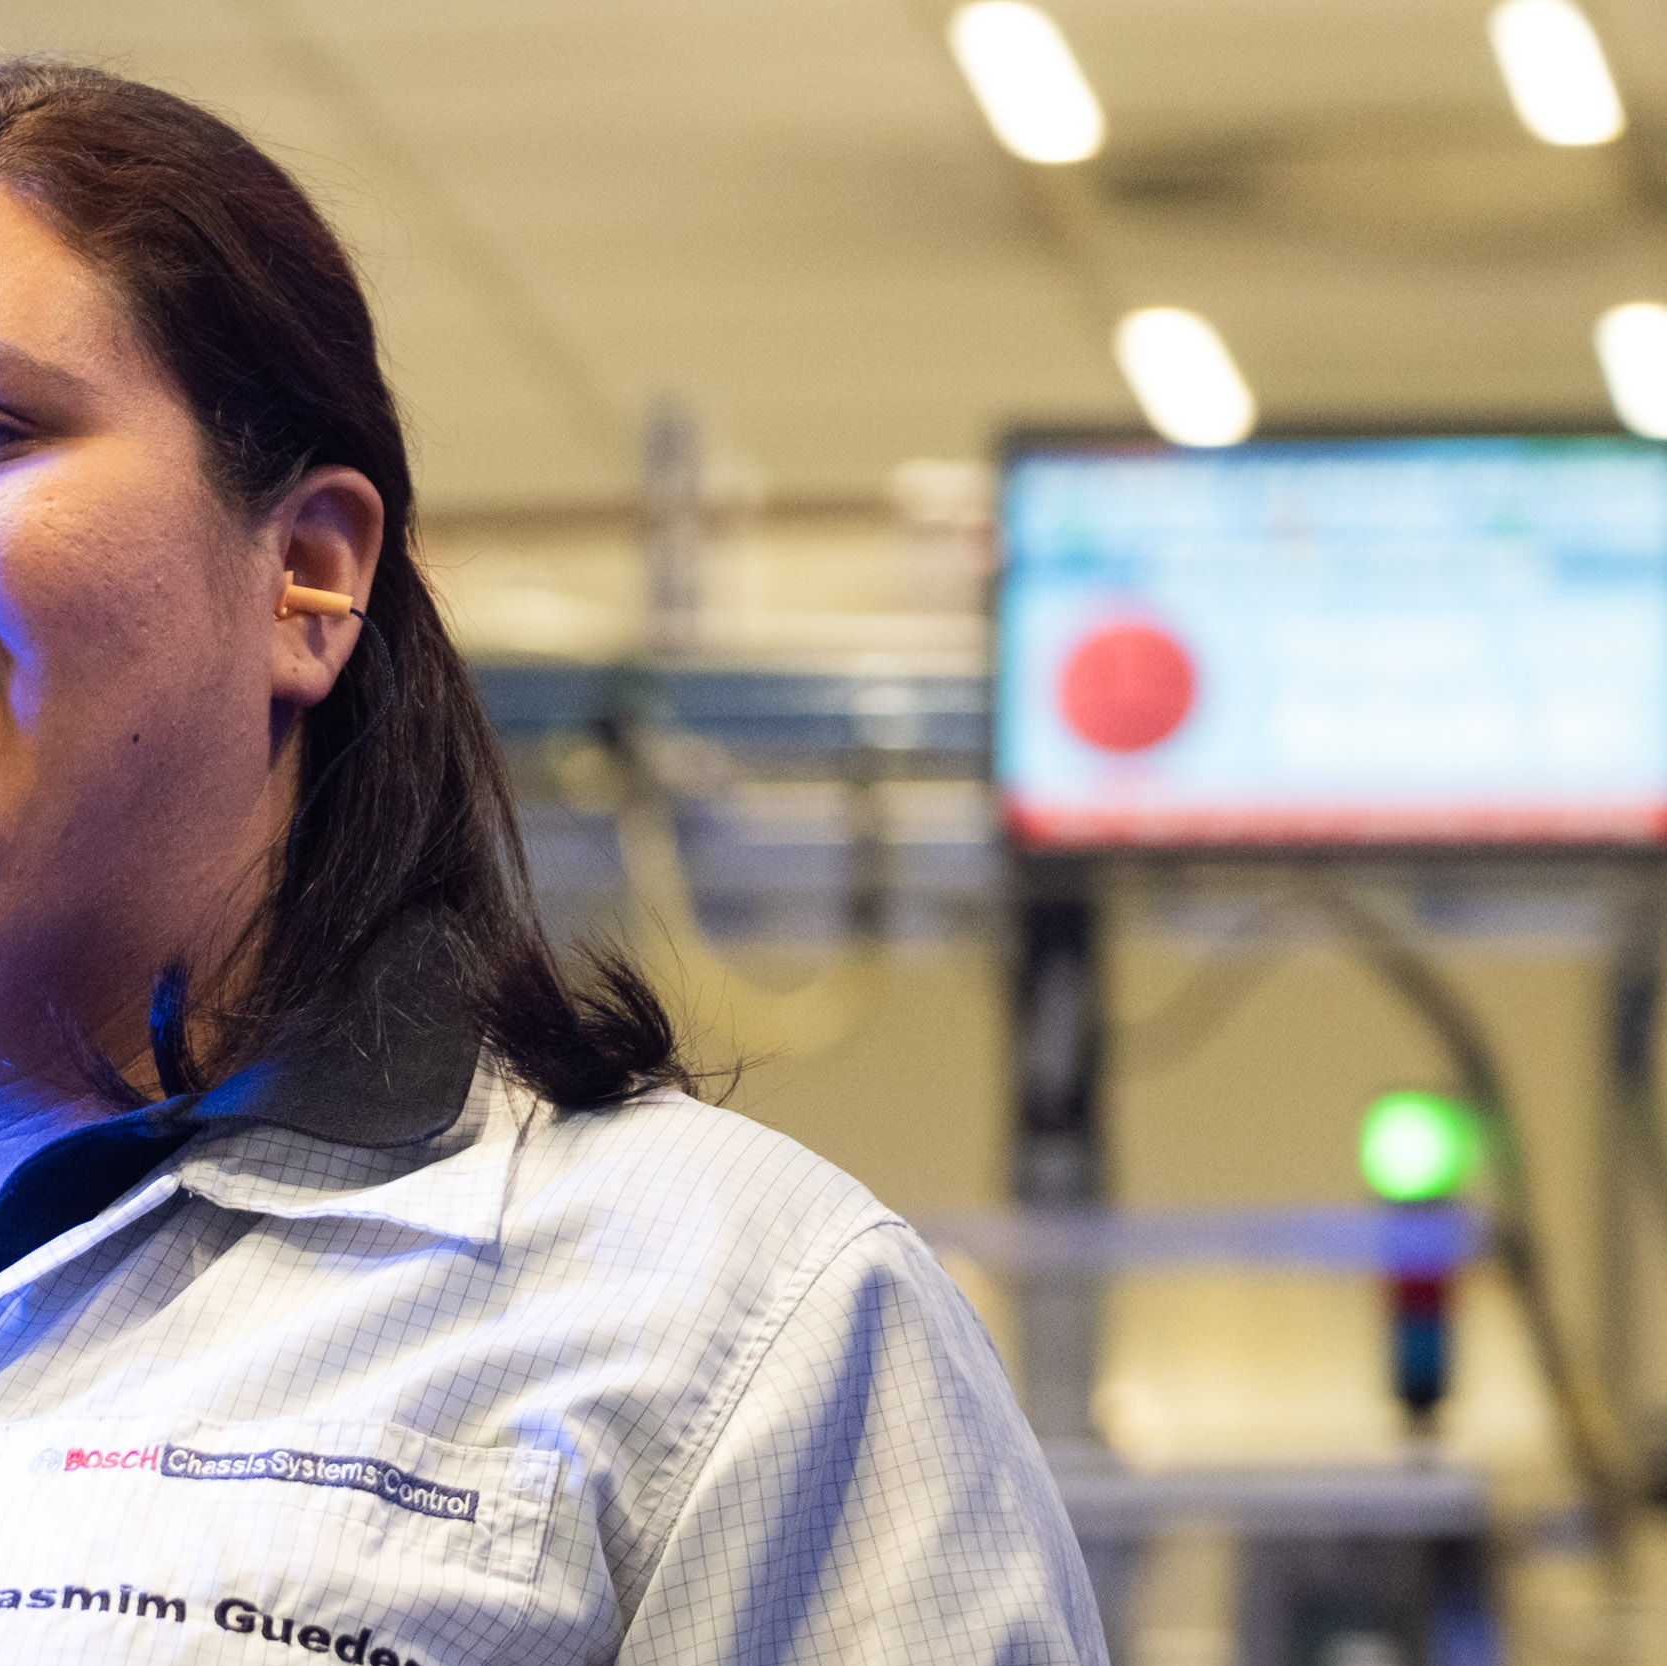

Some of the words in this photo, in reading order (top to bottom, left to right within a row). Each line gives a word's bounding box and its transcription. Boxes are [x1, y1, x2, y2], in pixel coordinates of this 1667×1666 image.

[63, 1444, 161, 1472] BOSCH
[167, 1448, 267, 1476] Chassis
[270, 1450, 379, 1486] Systems
[383, 1468, 473, 1515] Control
